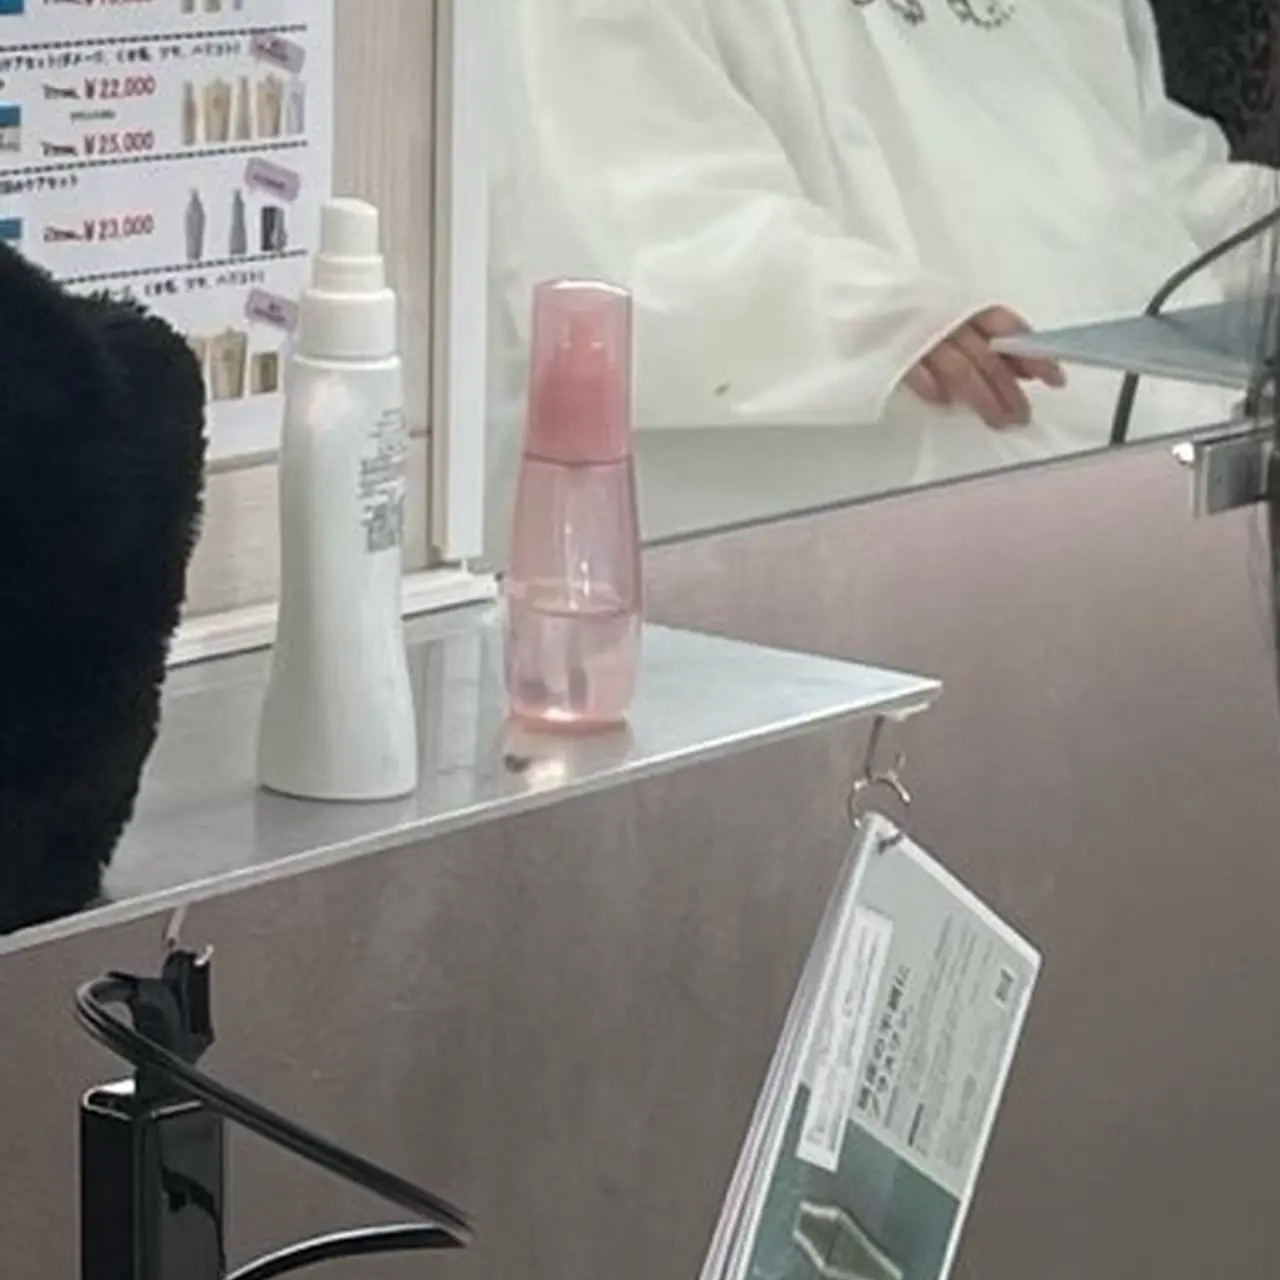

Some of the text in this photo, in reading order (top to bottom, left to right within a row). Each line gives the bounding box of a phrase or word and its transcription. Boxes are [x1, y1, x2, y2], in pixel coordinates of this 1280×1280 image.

[83, 75, 156, 102] ¥22,000
[83, 131, 155, 157] ¥25,000
[83, 213, 155, 240] ¥23,000
